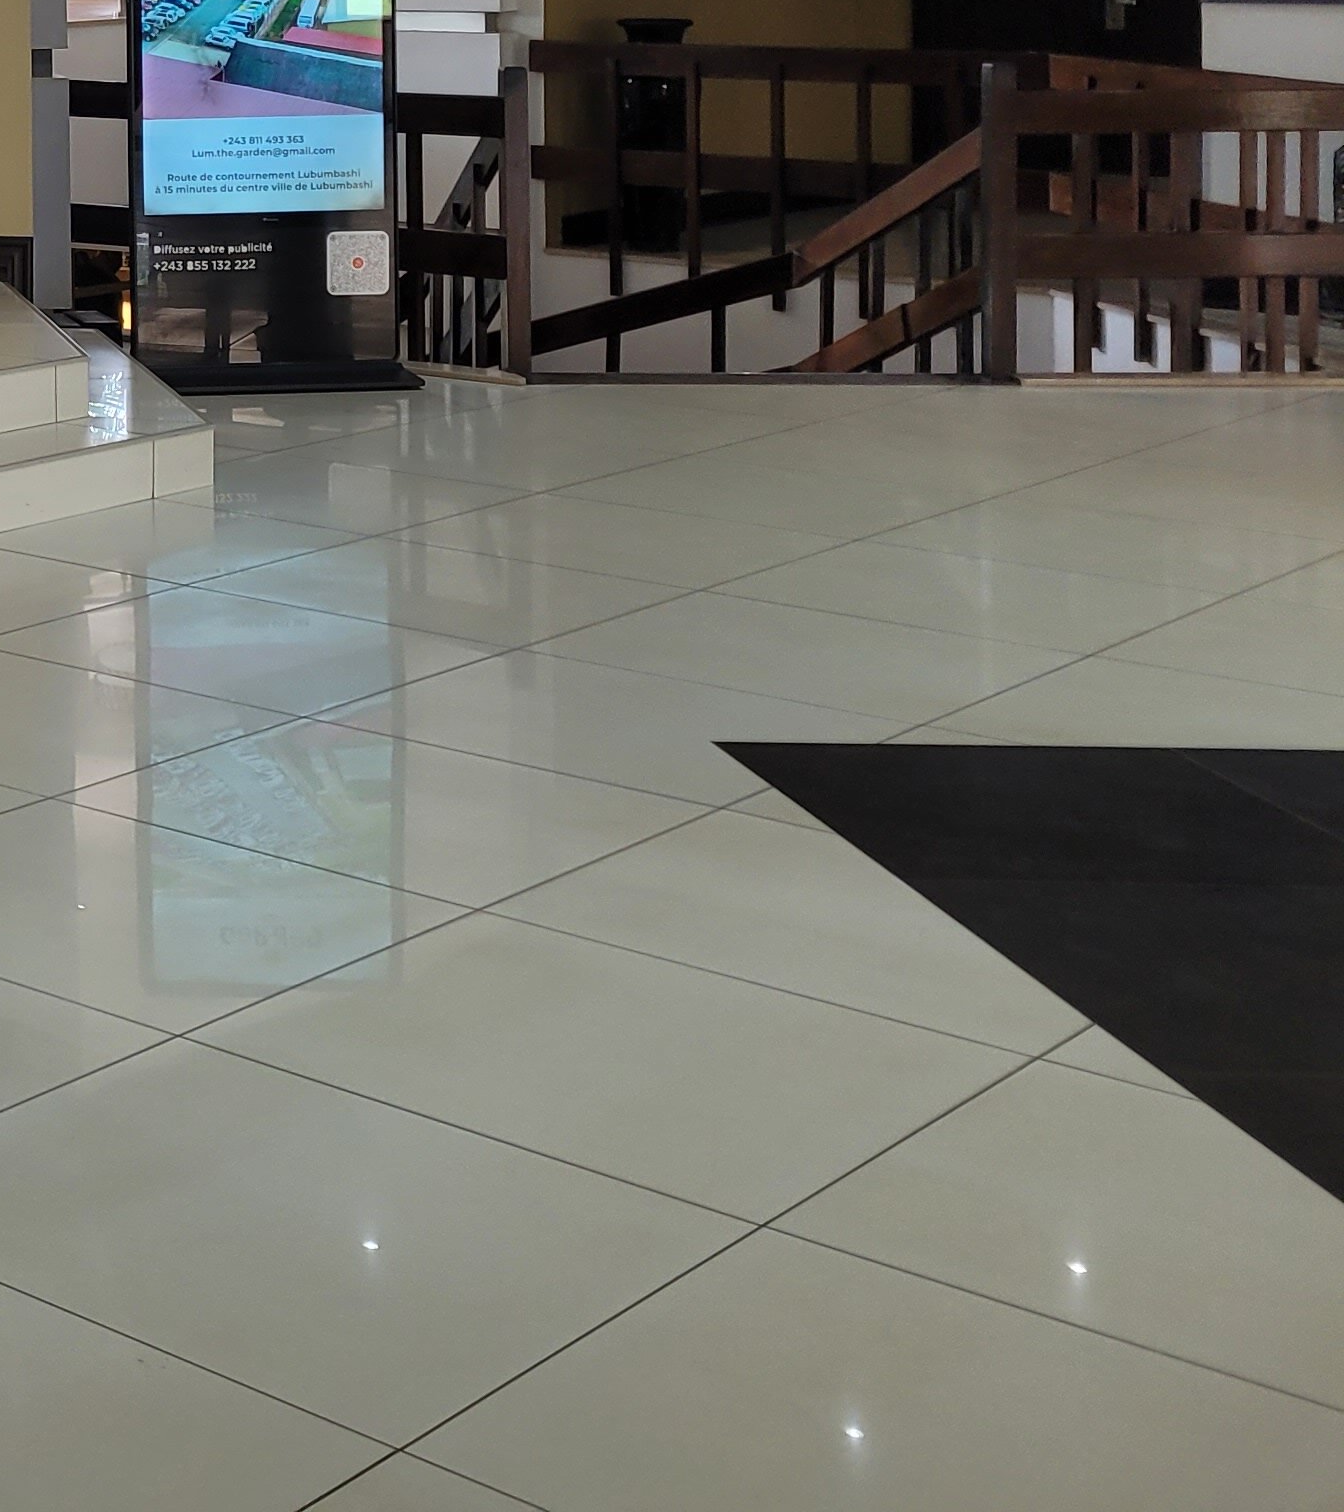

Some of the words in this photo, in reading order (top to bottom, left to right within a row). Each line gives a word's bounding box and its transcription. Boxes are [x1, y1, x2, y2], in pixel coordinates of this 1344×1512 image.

[223, 136, 246, 145] +243
[249, 136, 263, 145] 811
[266, 135, 284, 144] 493
[286, 135, 304, 144] 363
[167, 173, 197, 182] Route
[200, 172, 213, 181] de
[215, 171, 295, 181] contournement
[298, 168, 361, 179] Lubumbashi
[163, 185, 174, 194] 15
[176, 184, 218, 194] minutes
[220, 184, 233, 193] du
[236, 184, 269, 193] centre
[272, 182, 292, 192] ville
[294, 182, 308, 191] de
[311, 180, 373, 190] Lubumbashi
[153, 244, 195, 254] Diffusez
[198, 245, 225, 254] votre
[227, 242, 273, 255] publicité
[153, 260, 183, 272] +243
[186, 260, 208, 271] 855
[211, 260, 231, 270] 132
[234, 258, 256, 270] 222
